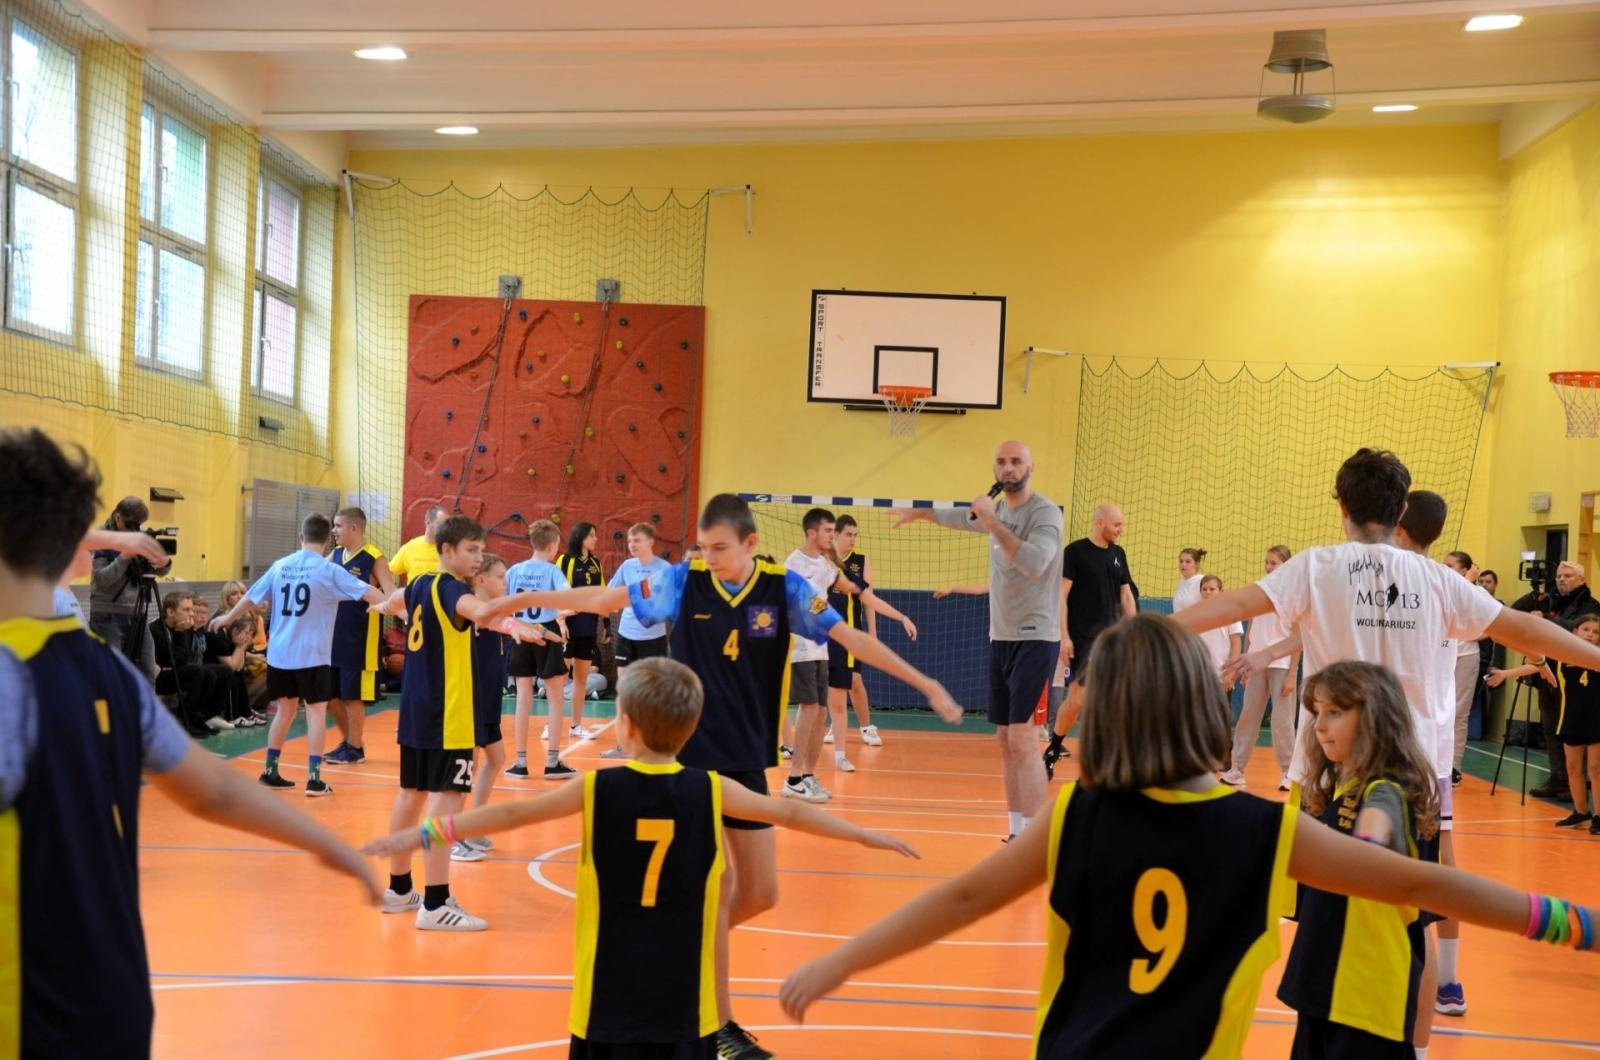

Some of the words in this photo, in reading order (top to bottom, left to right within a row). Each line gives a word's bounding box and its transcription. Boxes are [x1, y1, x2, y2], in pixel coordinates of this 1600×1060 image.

[281, 583, 311, 617] 19
[723, 628, 740, 662] 4
[1579, 670, 1589, 687] 4
[453, 759, 474, 786] 25
[636, 819, 675, 907] 7
[1129, 867, 1188, 995] 9
